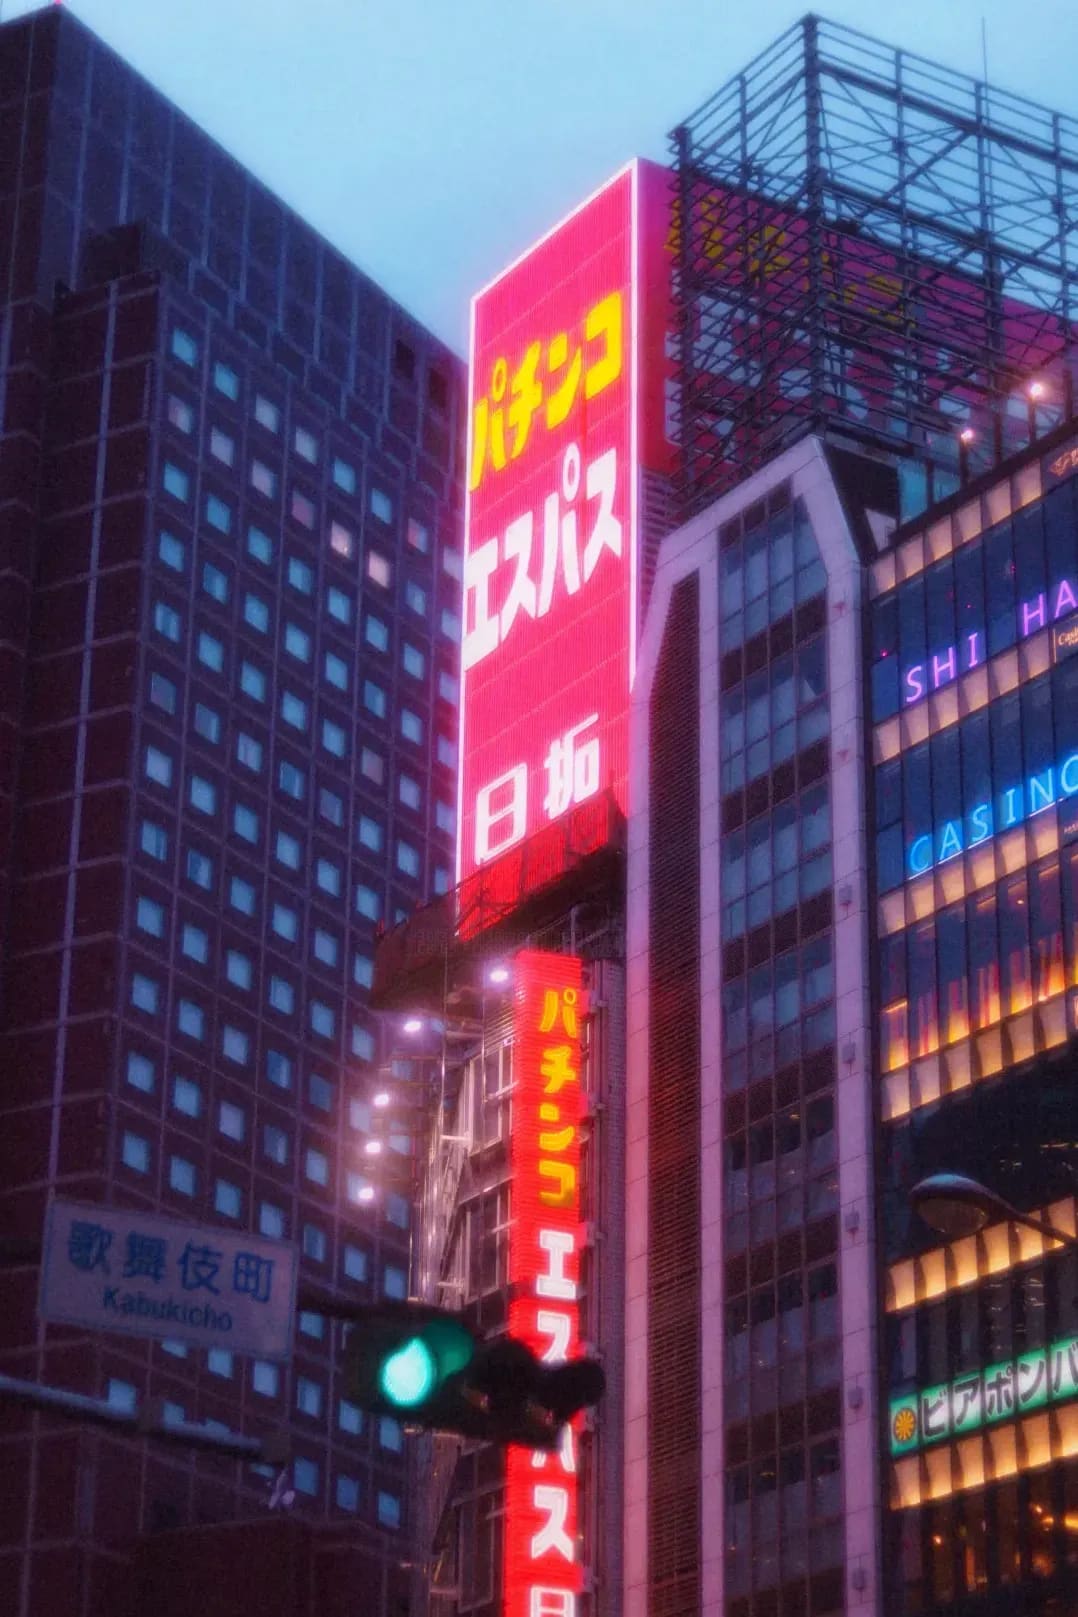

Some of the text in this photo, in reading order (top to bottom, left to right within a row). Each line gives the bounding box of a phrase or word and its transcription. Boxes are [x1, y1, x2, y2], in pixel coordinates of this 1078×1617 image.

[469, 290, 623, 493] パチンコ
[462, 442, 623, 673] エスパス
[905, 631, 979, 703] SHI
[538, 988, 578, 1206] パチンコ
[103, 1286, 234, 1332] Kabukicho
